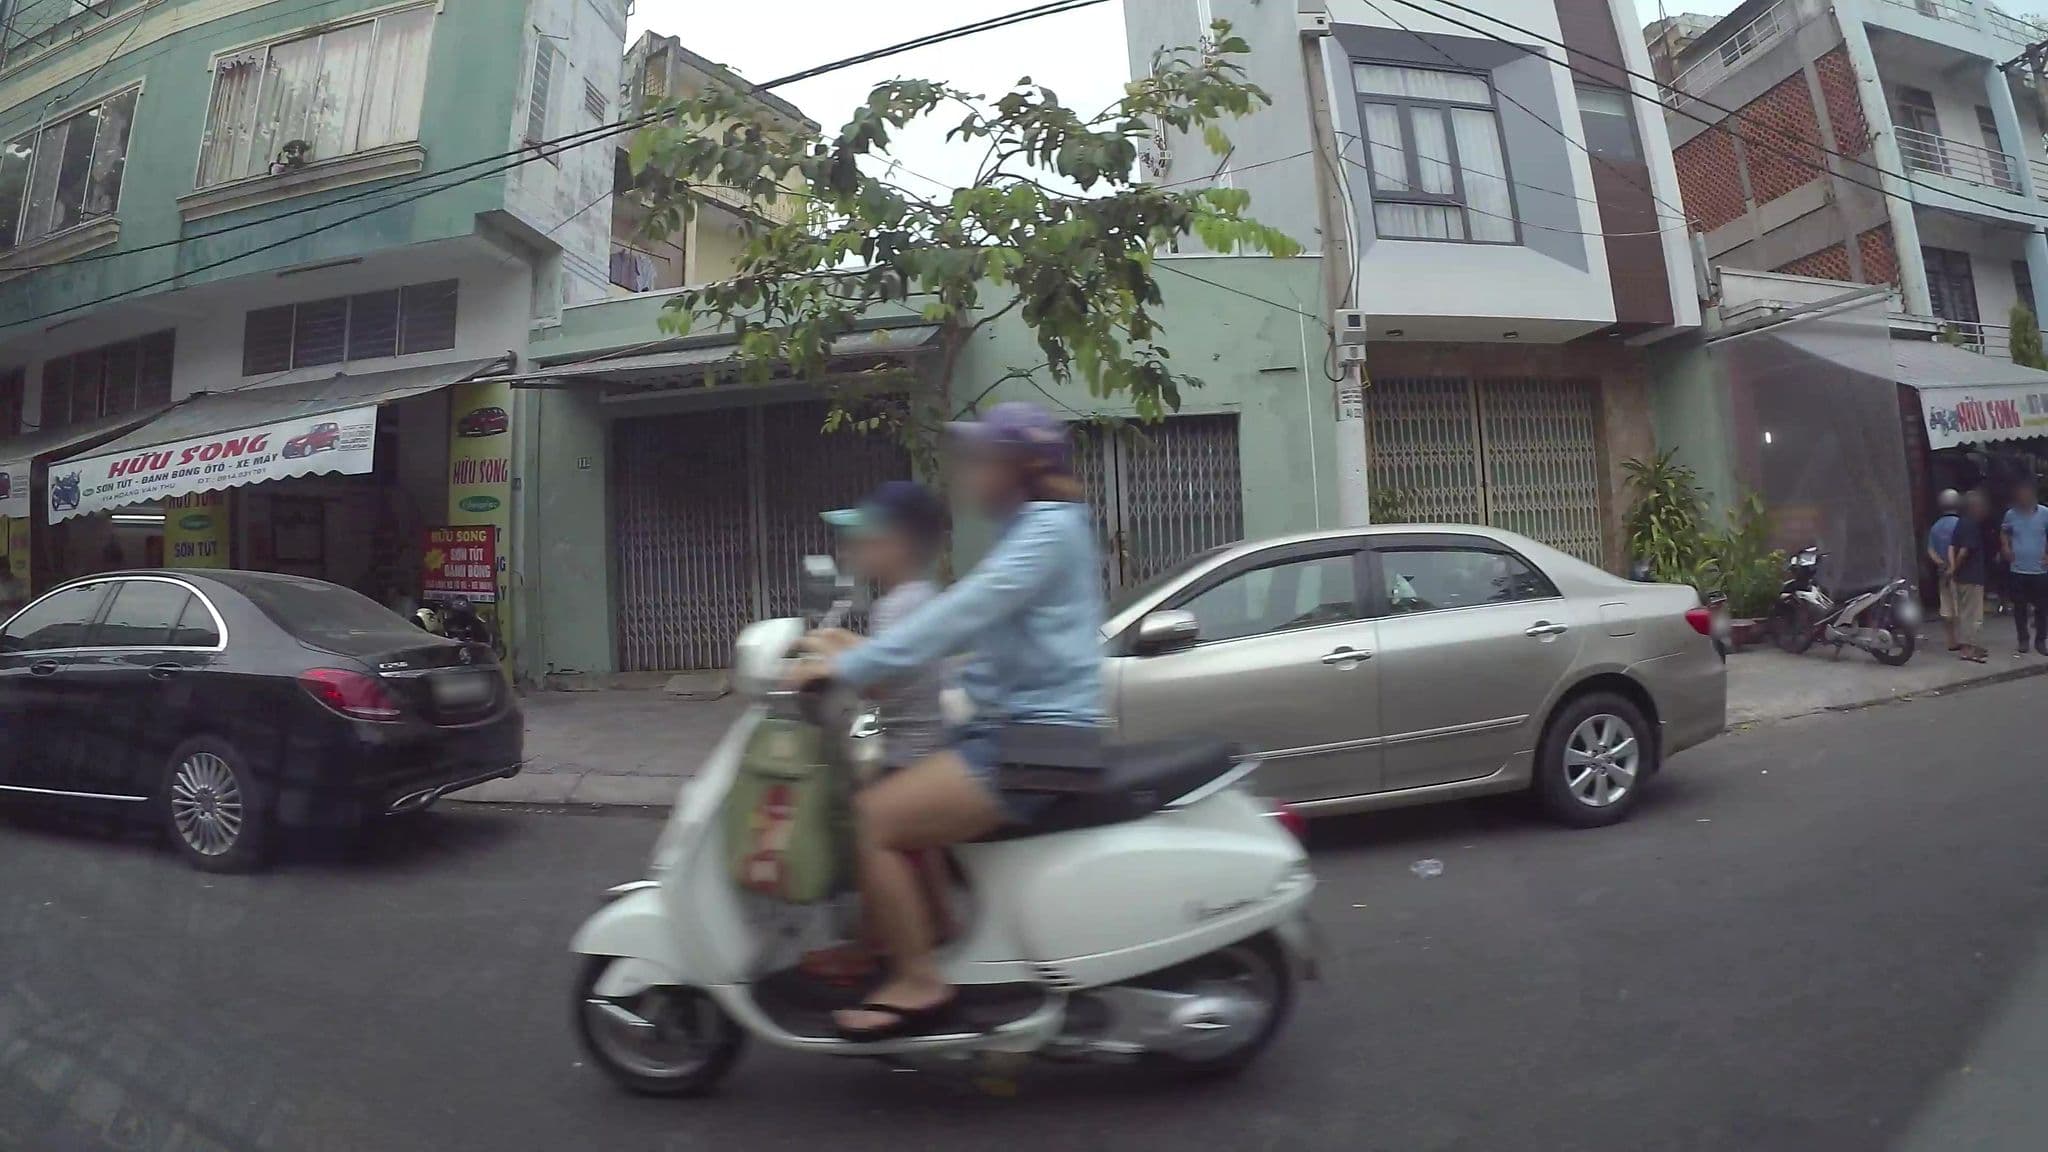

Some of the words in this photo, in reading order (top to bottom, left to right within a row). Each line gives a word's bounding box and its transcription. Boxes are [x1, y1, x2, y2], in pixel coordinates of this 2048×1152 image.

[1986, 399, 2021, 430] SONG
[107, 450, 174, 479] HỮU
[176, 433, 272, 465] SONG
[236, 459, 249, 468] XE
[480, 458, 509, 483] SONG
[456, 530, 487, 542] SONG
